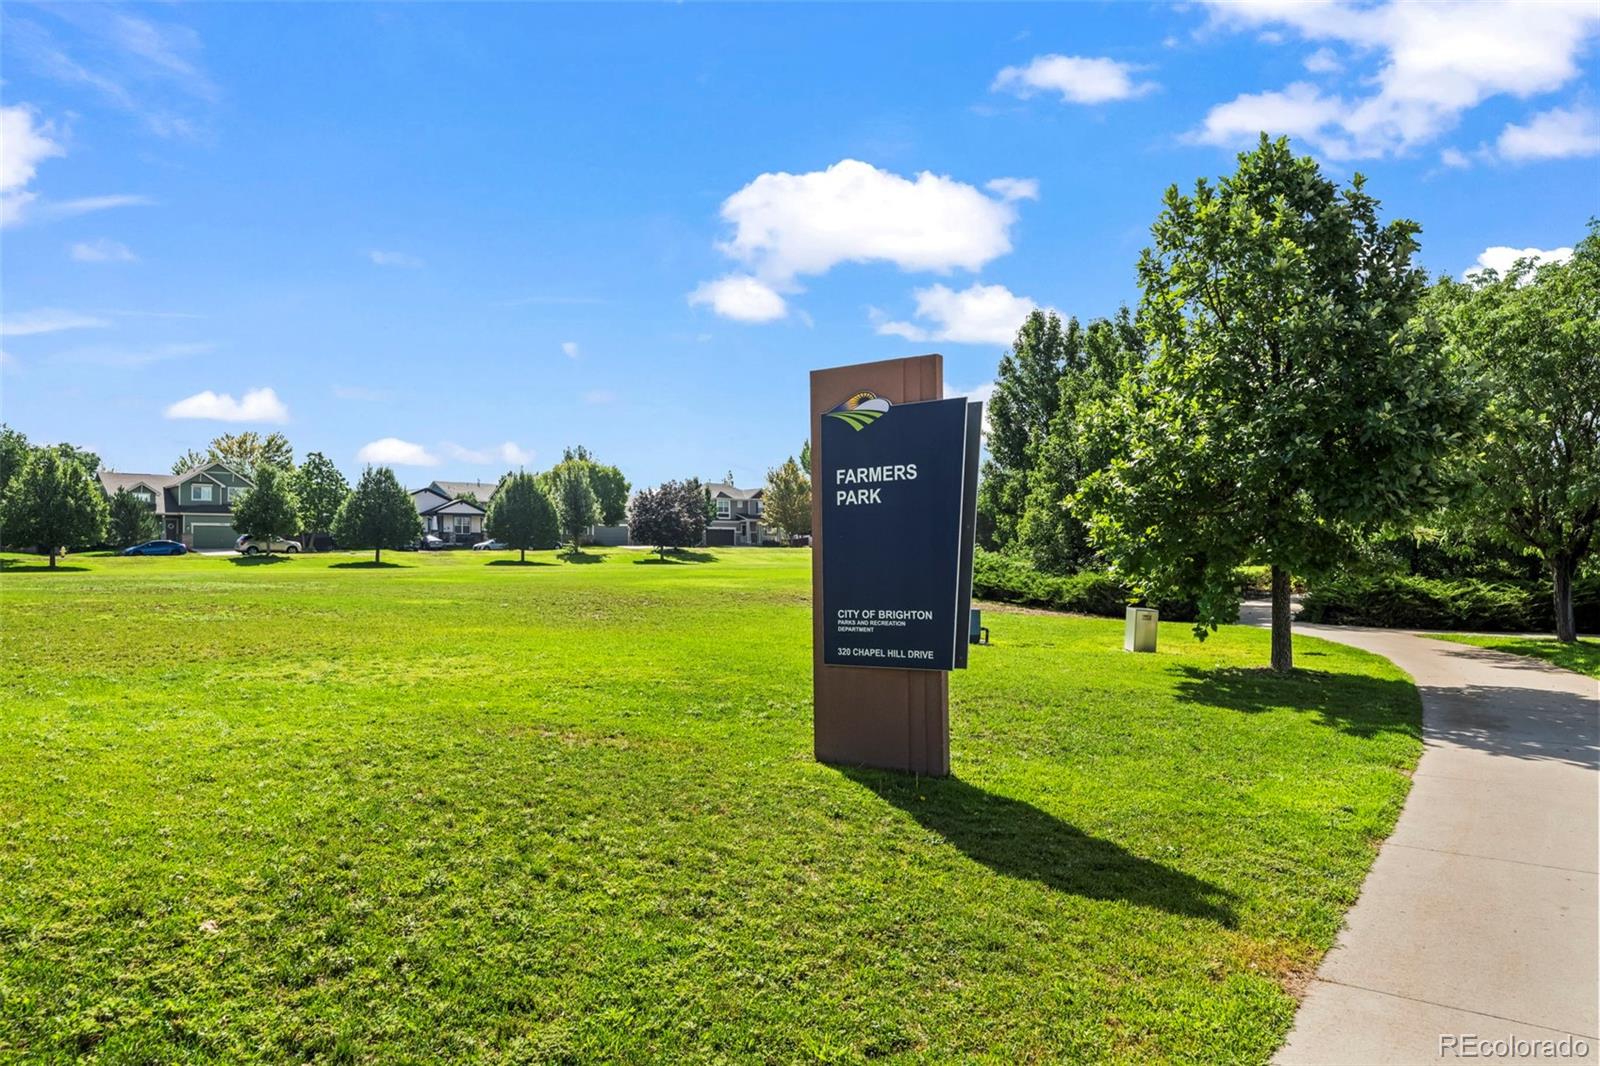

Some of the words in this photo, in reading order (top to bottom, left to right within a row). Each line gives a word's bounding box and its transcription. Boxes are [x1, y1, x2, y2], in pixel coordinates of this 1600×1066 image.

[836, 463, 918, 485] FARMERS
[836, 488, 882, 506] PARK
[837, 609, 860, 619] CITY
[862, 610, 875, 619] OF
[878, 610, 933, 620] BRIGHTON
[837, 647, 851, 656] 320
[852, 648, 885, 657] CHAPEL
[887, 649, 906, 658] HILL
[908, 650, 934, 659] DRIVE
